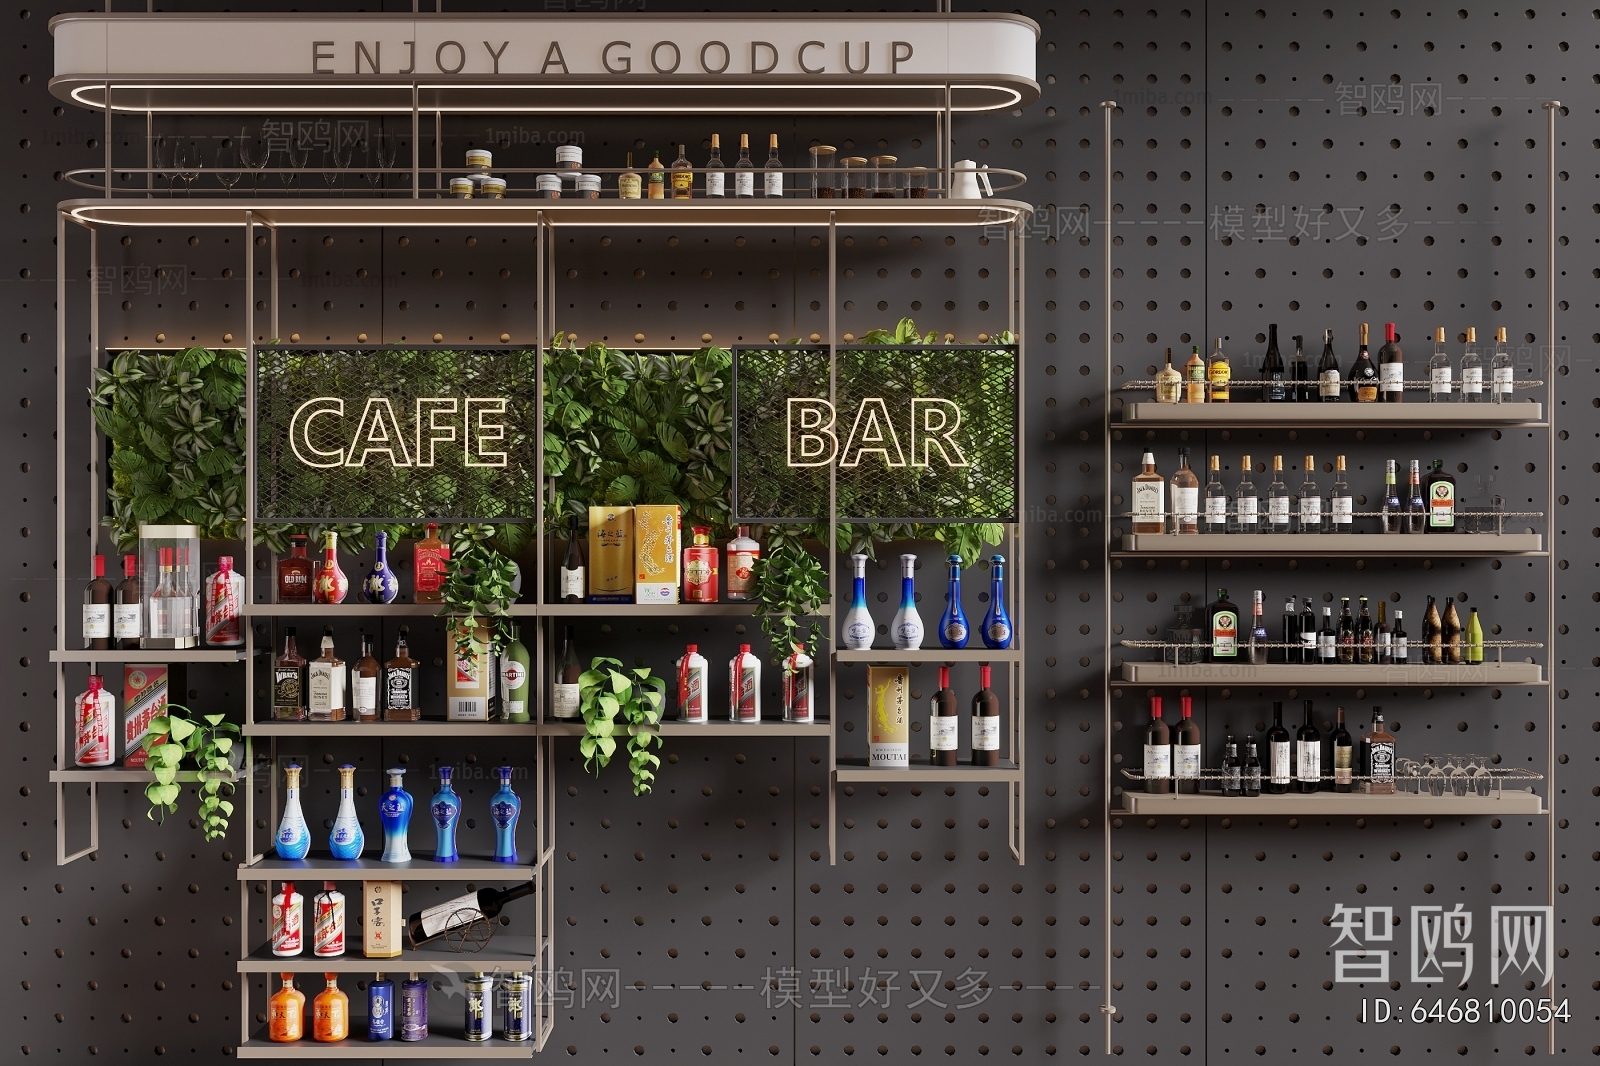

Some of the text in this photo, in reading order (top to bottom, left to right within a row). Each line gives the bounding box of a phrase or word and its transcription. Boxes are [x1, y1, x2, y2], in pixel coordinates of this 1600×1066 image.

[312, 41, 510, 75] ENJOY
[539, 41, 570, 75] A
[289, 396, 508, 468] CAFE
[787, 397, 970, 467] BAR
